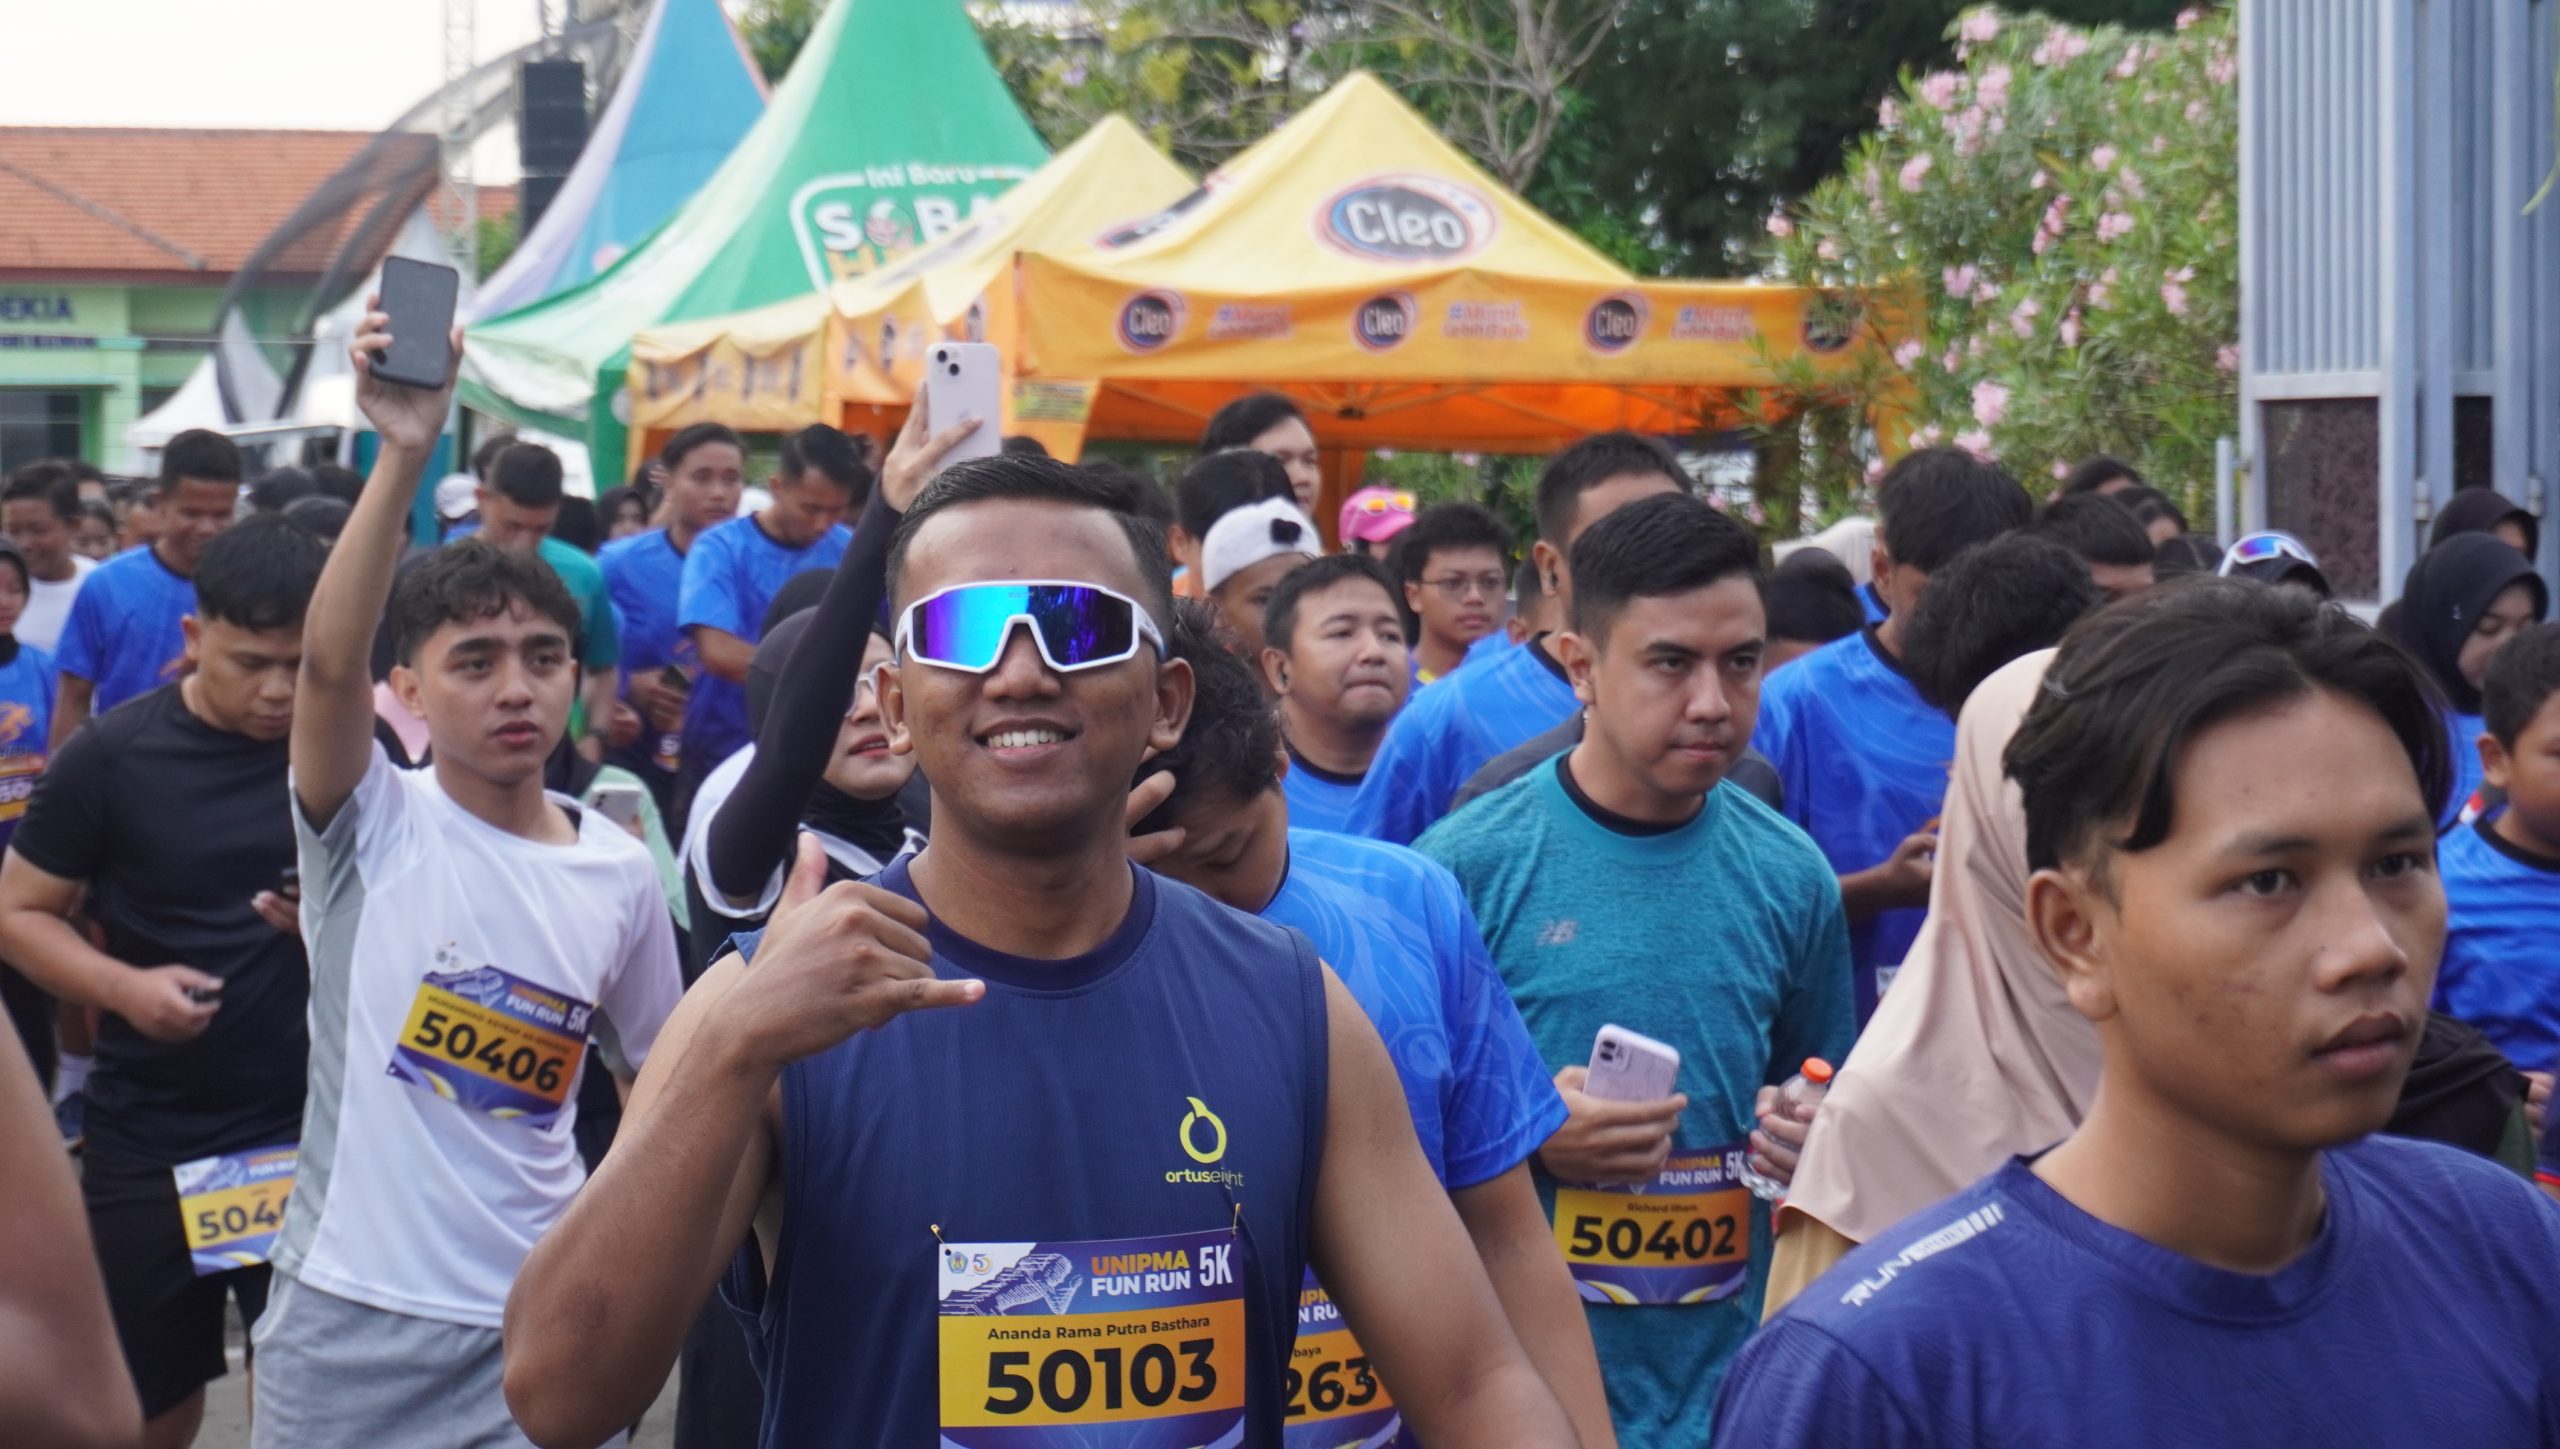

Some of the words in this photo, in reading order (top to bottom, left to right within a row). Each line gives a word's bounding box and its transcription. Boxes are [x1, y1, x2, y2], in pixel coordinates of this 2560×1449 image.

[865, 165, 905, 188] Ini
[906, 161, 978, 185] Baru
[1347, 201, 1467, 249] Cleo
[1128, 307, 1171, 335] Cleo
[1363, 306, 1404, 336] Cleo
[1595, 309, 1636, 337] Cleo
[506, 994, 537, 1016] FUN
[536, 1006, 564, 1026] RUN
[567, 1006, 592, 1034] 5K
[413, 1011, 566, 1092] 50406
[1659, 1170, 1692, 1186] FUN
[1693, 1168, 1722, 1184] RUN
[1726, 1151, 1745, 1180] 5K
[1627, 1203, 1668, 1213] Richard
[1570, 1215, 1736, 1260] 50402
[1091, 1250, 1190, 1276] UNIPMA
[1091, 1274, 1140, 1297] FUN
[1145, 1271, 1191, 1293] RUN
[1199, 1244, 1232, 1287] 5K
[987, 1328, 1051, 1340] Ananda
[1056, 1325, 1101, 1338] Rama
[1106, 1322, 1147, 1336] Putra
[1151, 1315, 1210, 1332] Basthara
[1313, 1303, 1340, 1322] RU
[1294, 1346, 1322, 1358] baya
[984, 1337, 1217, 1415] 50103
[1285, 1357, 1377, 1416] 263
